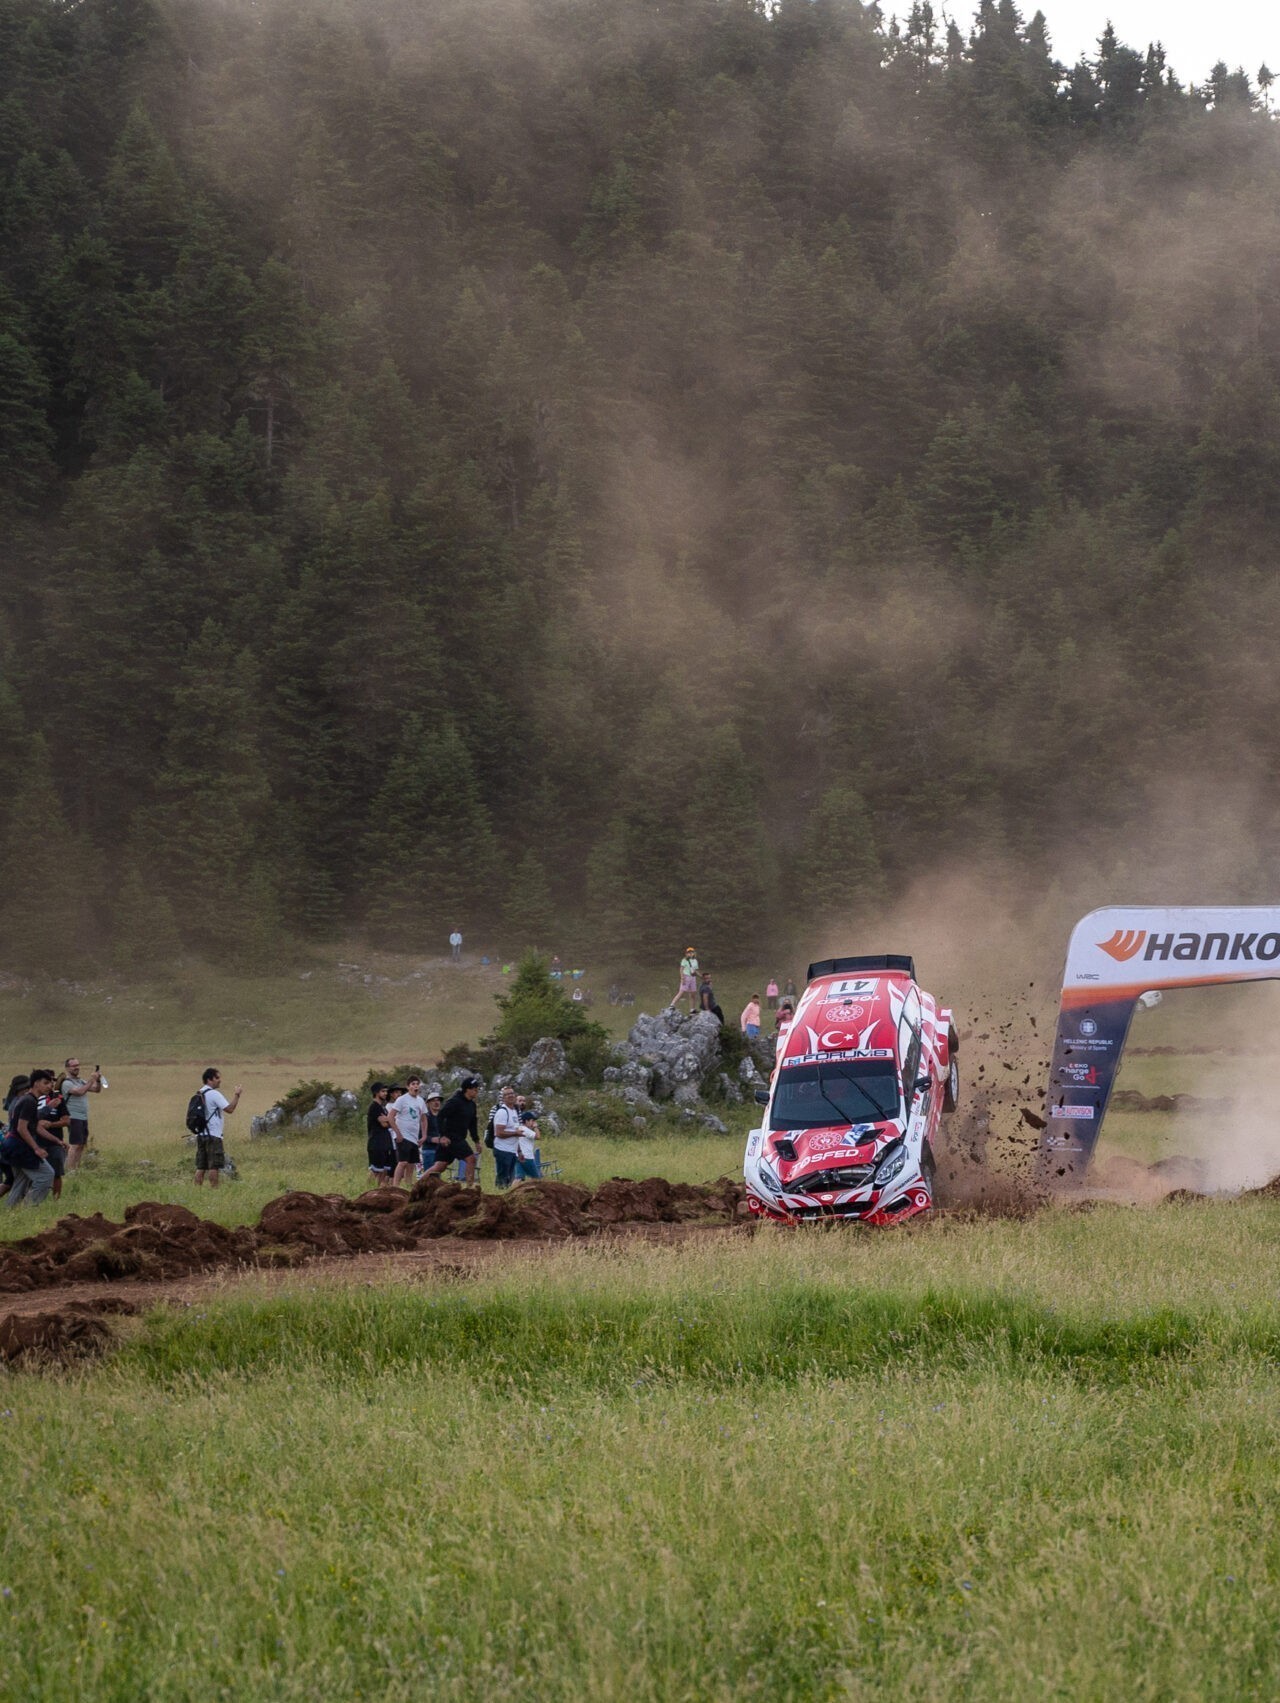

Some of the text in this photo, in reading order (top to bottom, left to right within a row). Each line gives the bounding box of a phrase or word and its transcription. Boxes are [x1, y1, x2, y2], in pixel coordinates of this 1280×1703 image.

[839, 981, 870, 992] 41
[804, 1050, 888, 1062] FORUM8
[792, 1149, 859, 1172] TOSFED
